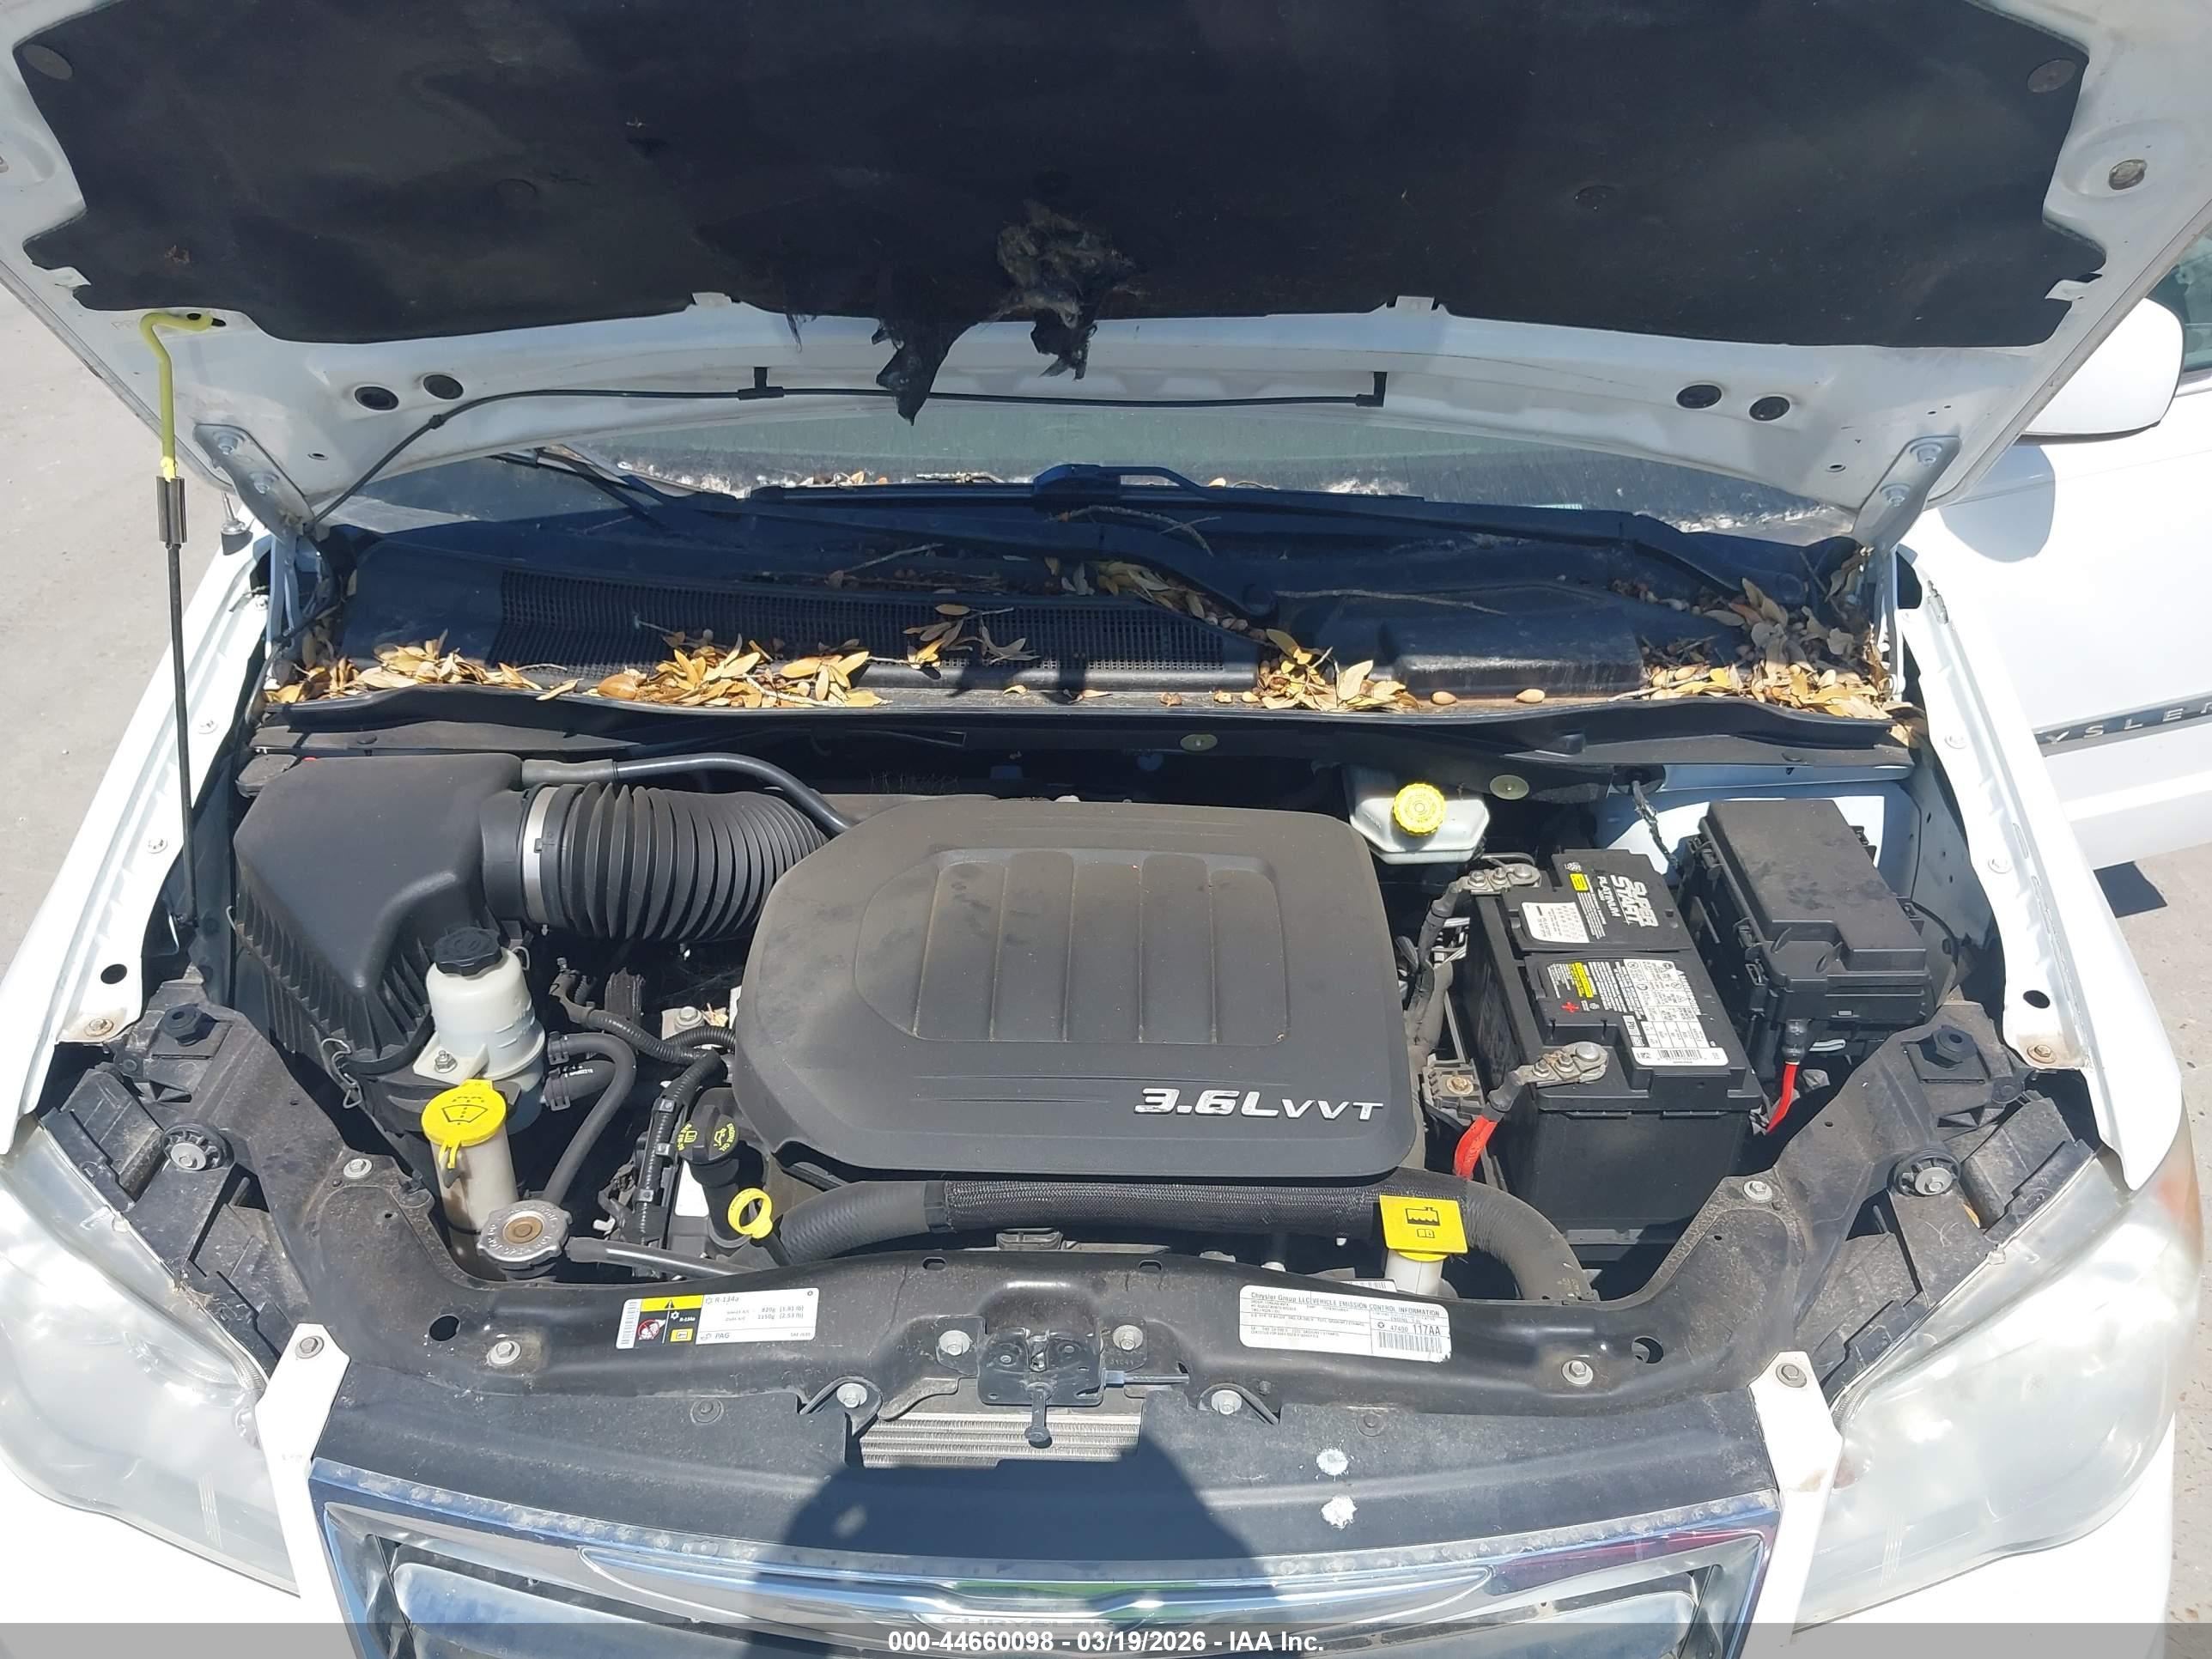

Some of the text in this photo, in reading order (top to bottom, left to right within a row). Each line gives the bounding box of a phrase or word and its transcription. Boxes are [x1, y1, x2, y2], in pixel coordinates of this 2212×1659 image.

[2037, 702, 2212, 745] YSLE
[1597, 876, 1621, 917] PLATINUM
[1610, 874, 1643, 927] START
[1632, 881, 1659, 927] SUPER
[1133, 1087, 1384, 1121] 3.6L VVT
[719, 1122, 736, 1152] ENGINE OIL
[1250, 1291, 1276, 1301] Chrysler
[1278, 1294, 1297, 1303] Group
[1312, 1297, 1336, 1306] VEHICLE
[1339, 1300, 1367, 1310] EMISSION
[1369, 1304, 1396, 1312] CONTROL
[1398, 1307, 1440, 1317] INFORMATION
[1413, 1323, 1442, 1336] 117AA
